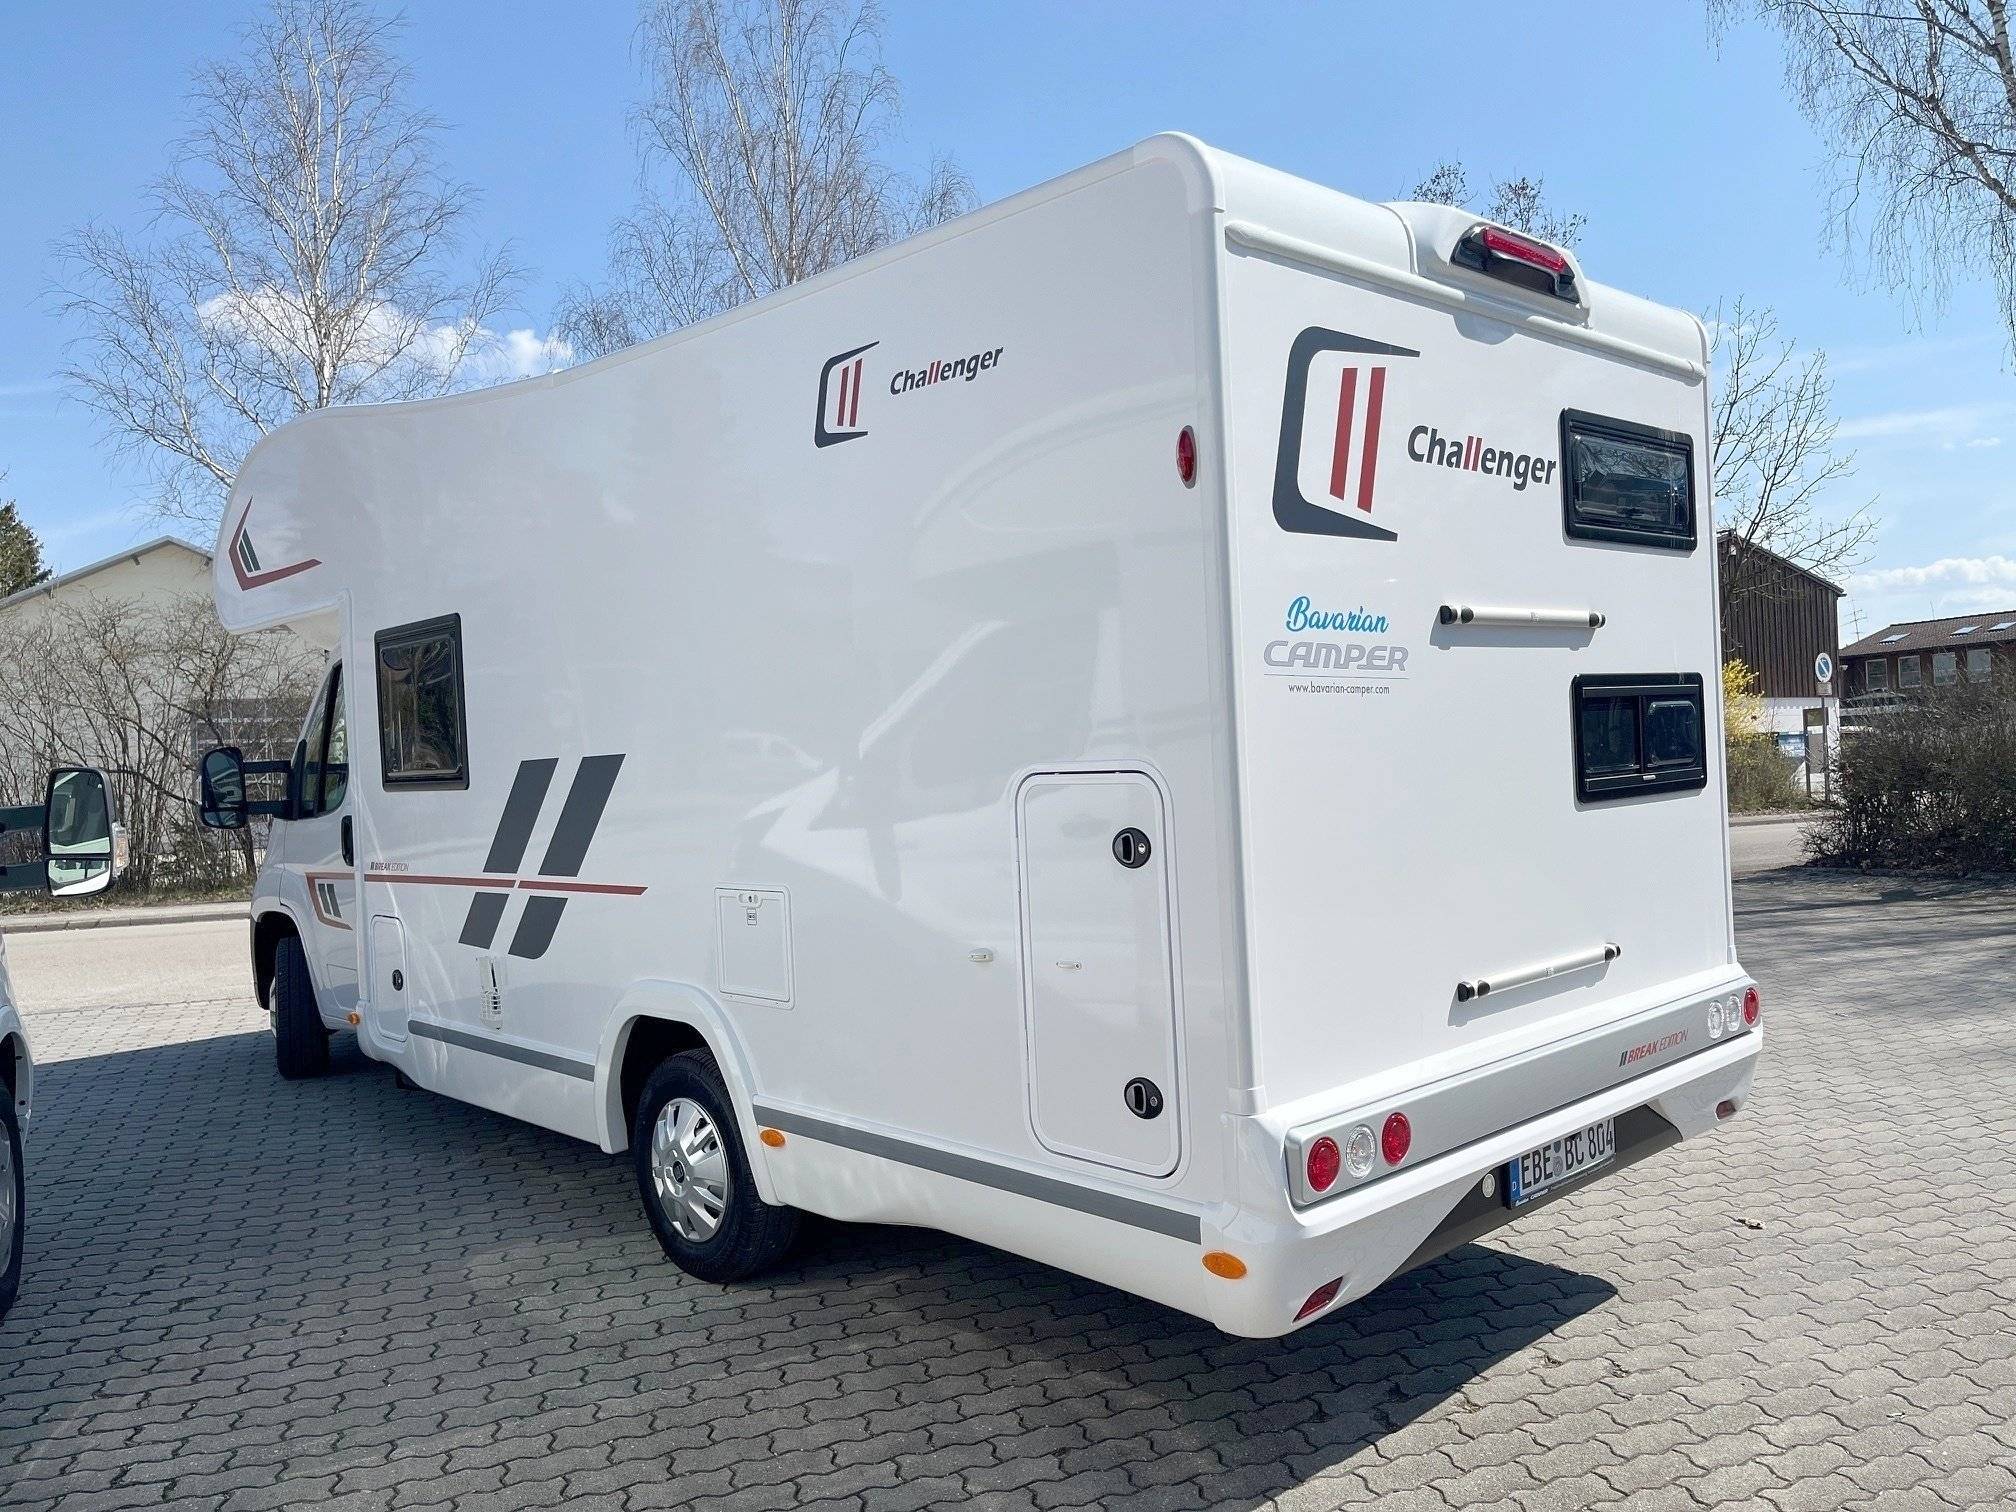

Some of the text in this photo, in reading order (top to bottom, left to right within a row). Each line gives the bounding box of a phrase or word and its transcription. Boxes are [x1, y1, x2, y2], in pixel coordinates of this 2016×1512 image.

[889, 346, 1004, 396] Challenger
[1407, 424, 1557, 492] Challenger
[1286, 595, 1390, 634] Bavarian
[1263, 640, 1409, 672] CAMPER
[1288, 681, 1390, 698] www.bavarian-camper.com
[1626, 1028, 1689, 1064] BREAK EDITION
[1521, 1118, 1614, 1190] EBE BC 804
